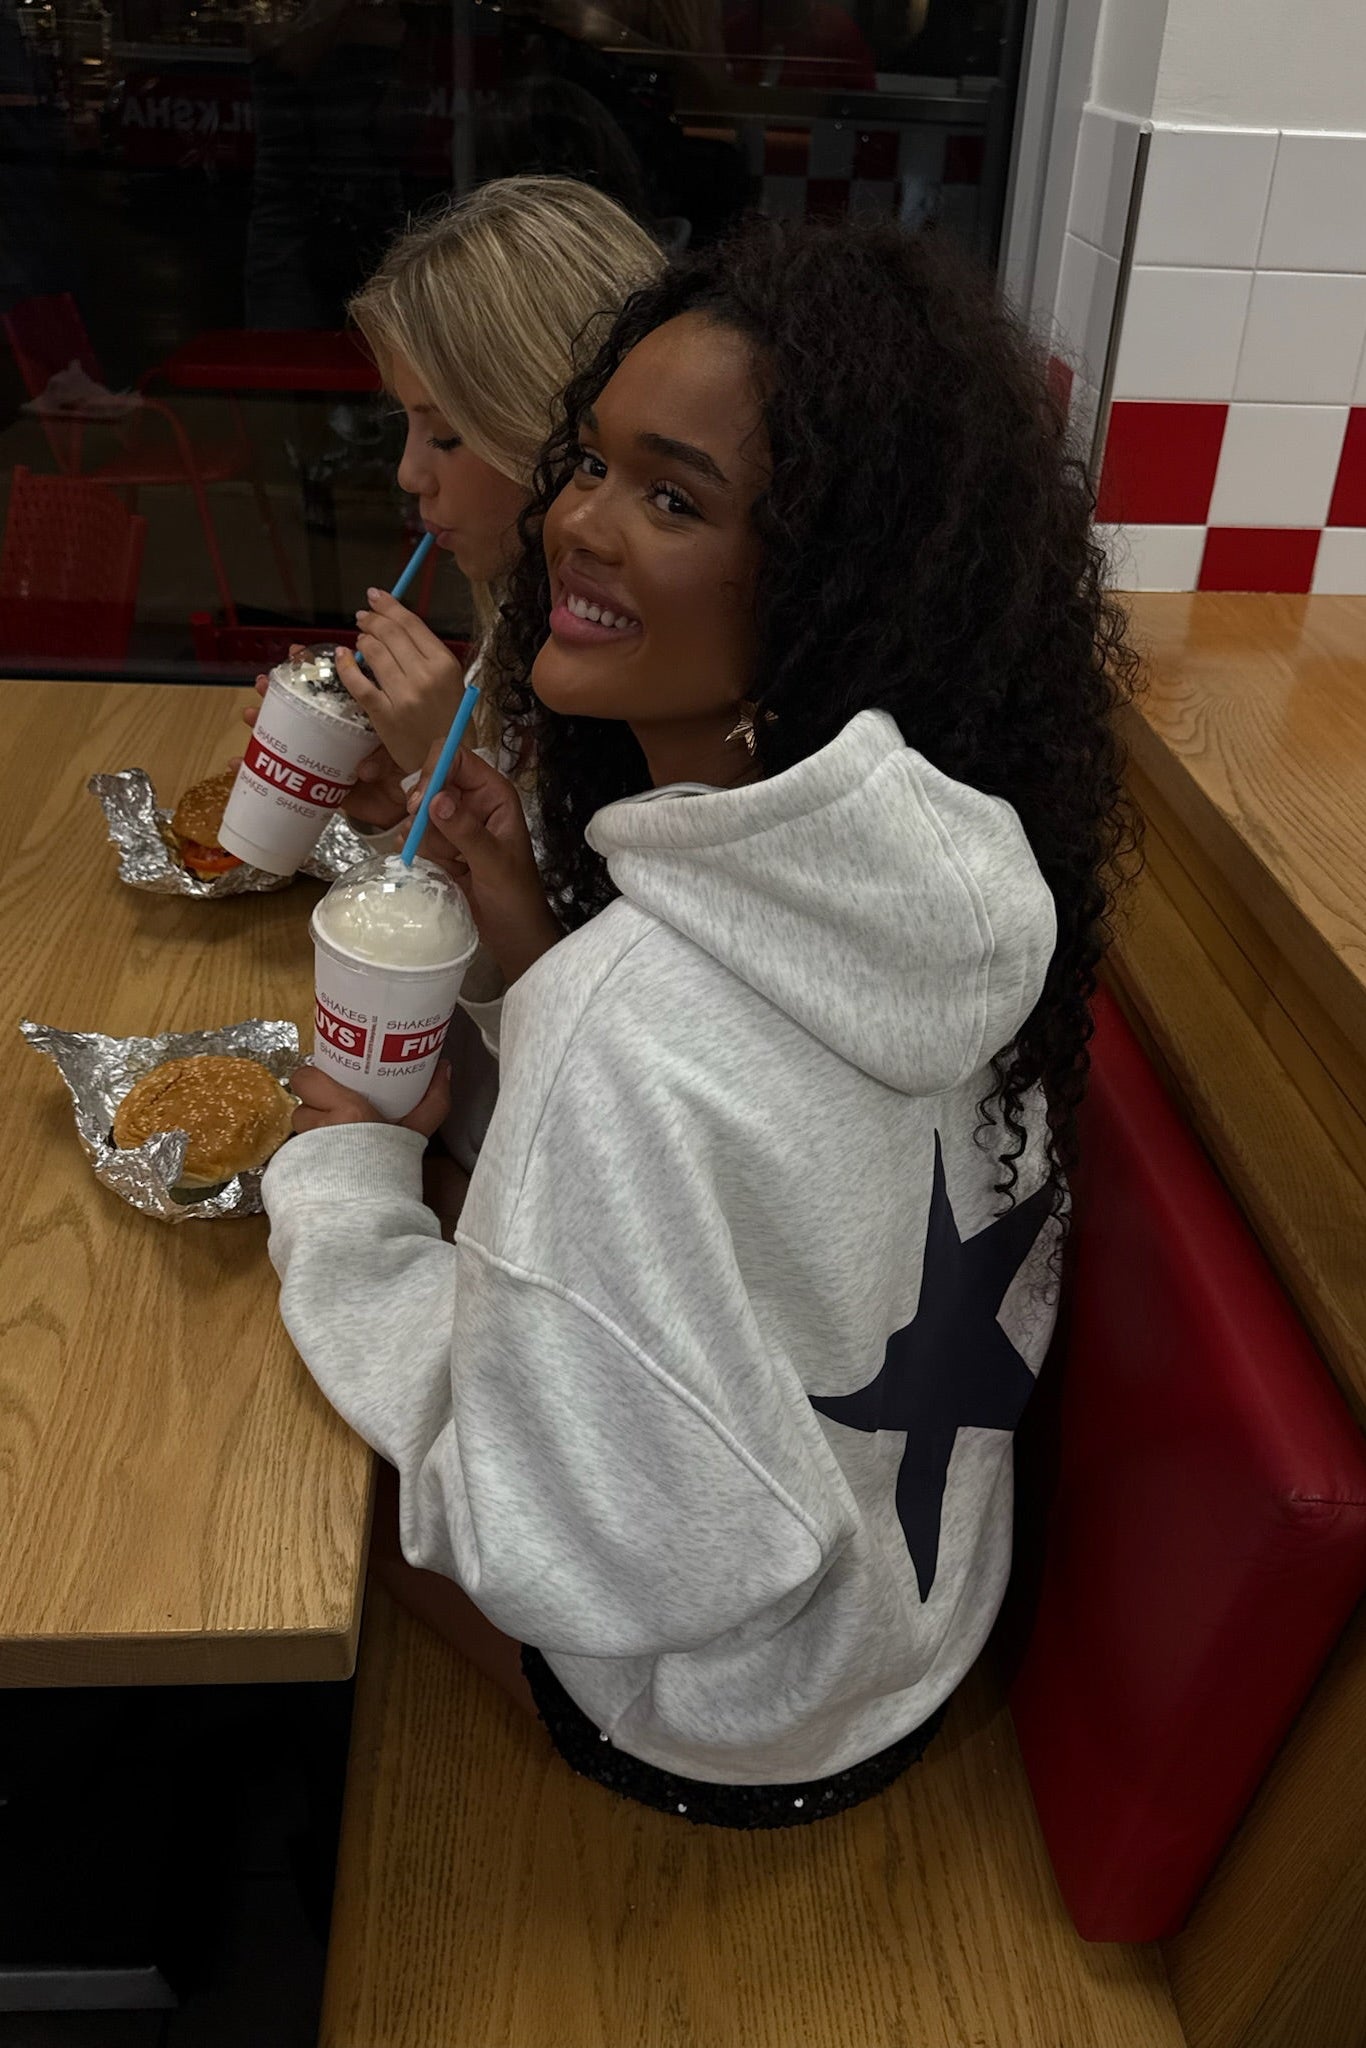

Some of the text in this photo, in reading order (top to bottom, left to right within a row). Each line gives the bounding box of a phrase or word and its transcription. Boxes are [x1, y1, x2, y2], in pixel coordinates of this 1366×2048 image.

[256, 725, 289, 754] SHAKES
[296, 754, 343, 778] SHAKES
[239, 770, 269, 797] SHAKES
[275, 796, 317, 819] SHAKES
[254, 751, 351, 806] FIVE GUY
[315, 1004, 356, 1049] UYS
[320, 991, 441, 1031] SHAKES SHAKES
[319, 1041, 426, 1078] SHAKES SHAKES
